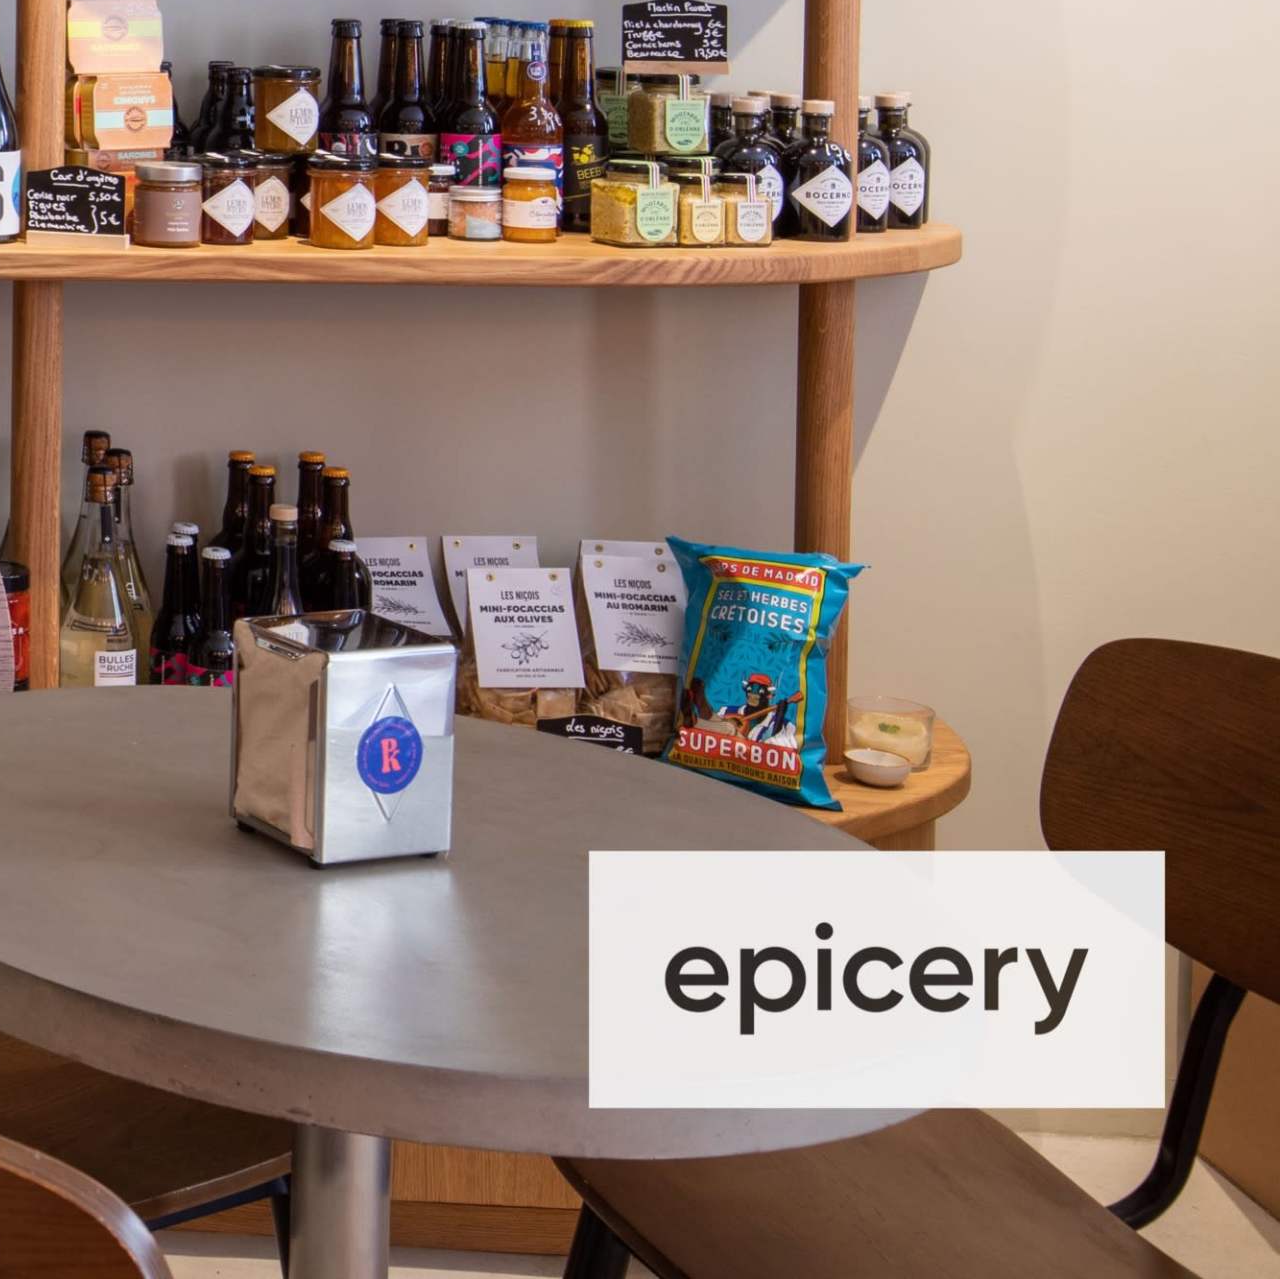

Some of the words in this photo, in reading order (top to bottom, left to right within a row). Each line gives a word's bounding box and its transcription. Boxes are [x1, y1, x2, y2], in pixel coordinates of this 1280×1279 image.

[624, 30, 665, 42] Truffe
[29, 201, 67, 214] Figues
[29, 210, 80, 222] Rhubarbe
[100, 211, 121, 226] 5€
[378, 557, 401, 569] NIÇOIS
[473, 557, 487, 567] LES
[487, 557, 510, 568] NIÇOIS
[371, 569, 425, 579] FOCACCIAS
[742, 565, 760, 578] DE
[763, 567, 819, 588] MADRID
[373, 579, 418, 588] ROMARIN
[613, 578, 627, 589] LES
[628, 578, 652, 591] NIÇOIS
[500, 590, 513, 601] LES
[514, 590, 540, 602] NIÇOIS
[593, 591, 678, 603] MINI-FOCACCIAS
[716, 588, 737, 602] SEL
[751, 590, 809, 615] HERBES
[479, 604, 565, 614] MINI-FOCACCIAS
[606, 601, 620, 611] AU
[621, 603, 669, 613] ROMARIN
[493, 614, 514, 624] AUX
[516, 614, 554, 624] OLIVES
[710, 602, 806, 635] CRÉTOISES
[99, 653, 135, 665] BULLES
[107, 662, 134, 672] RUCHE
[677, 729, 797, 772] SUPERBON
[767, 770, 800, 789] RAISON
